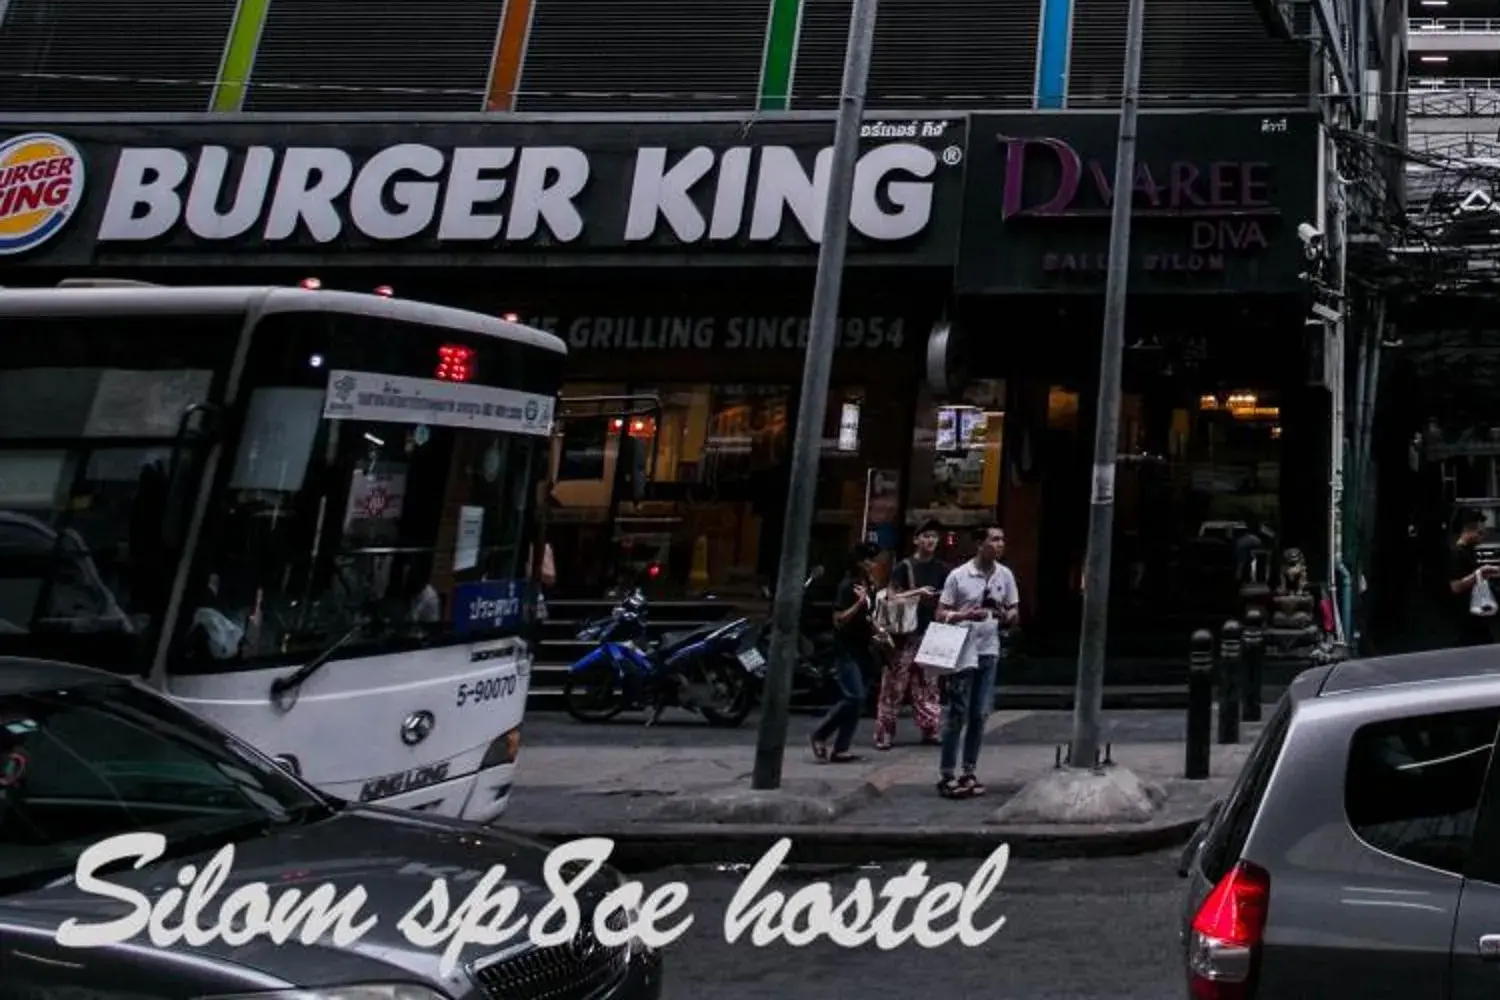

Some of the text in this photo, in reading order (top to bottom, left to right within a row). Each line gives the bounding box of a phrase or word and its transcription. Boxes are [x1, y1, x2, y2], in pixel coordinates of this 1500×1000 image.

[0, 157, 74, 188] URGER
[0, 178, 72, 216] ING
[97, 143, 937, 242] BURGER KING
[1191, 221, 1267, 249] DIVA
[568, 316, 715, 350] GRILLING
[456, 674, 517, 707] 5-90070
